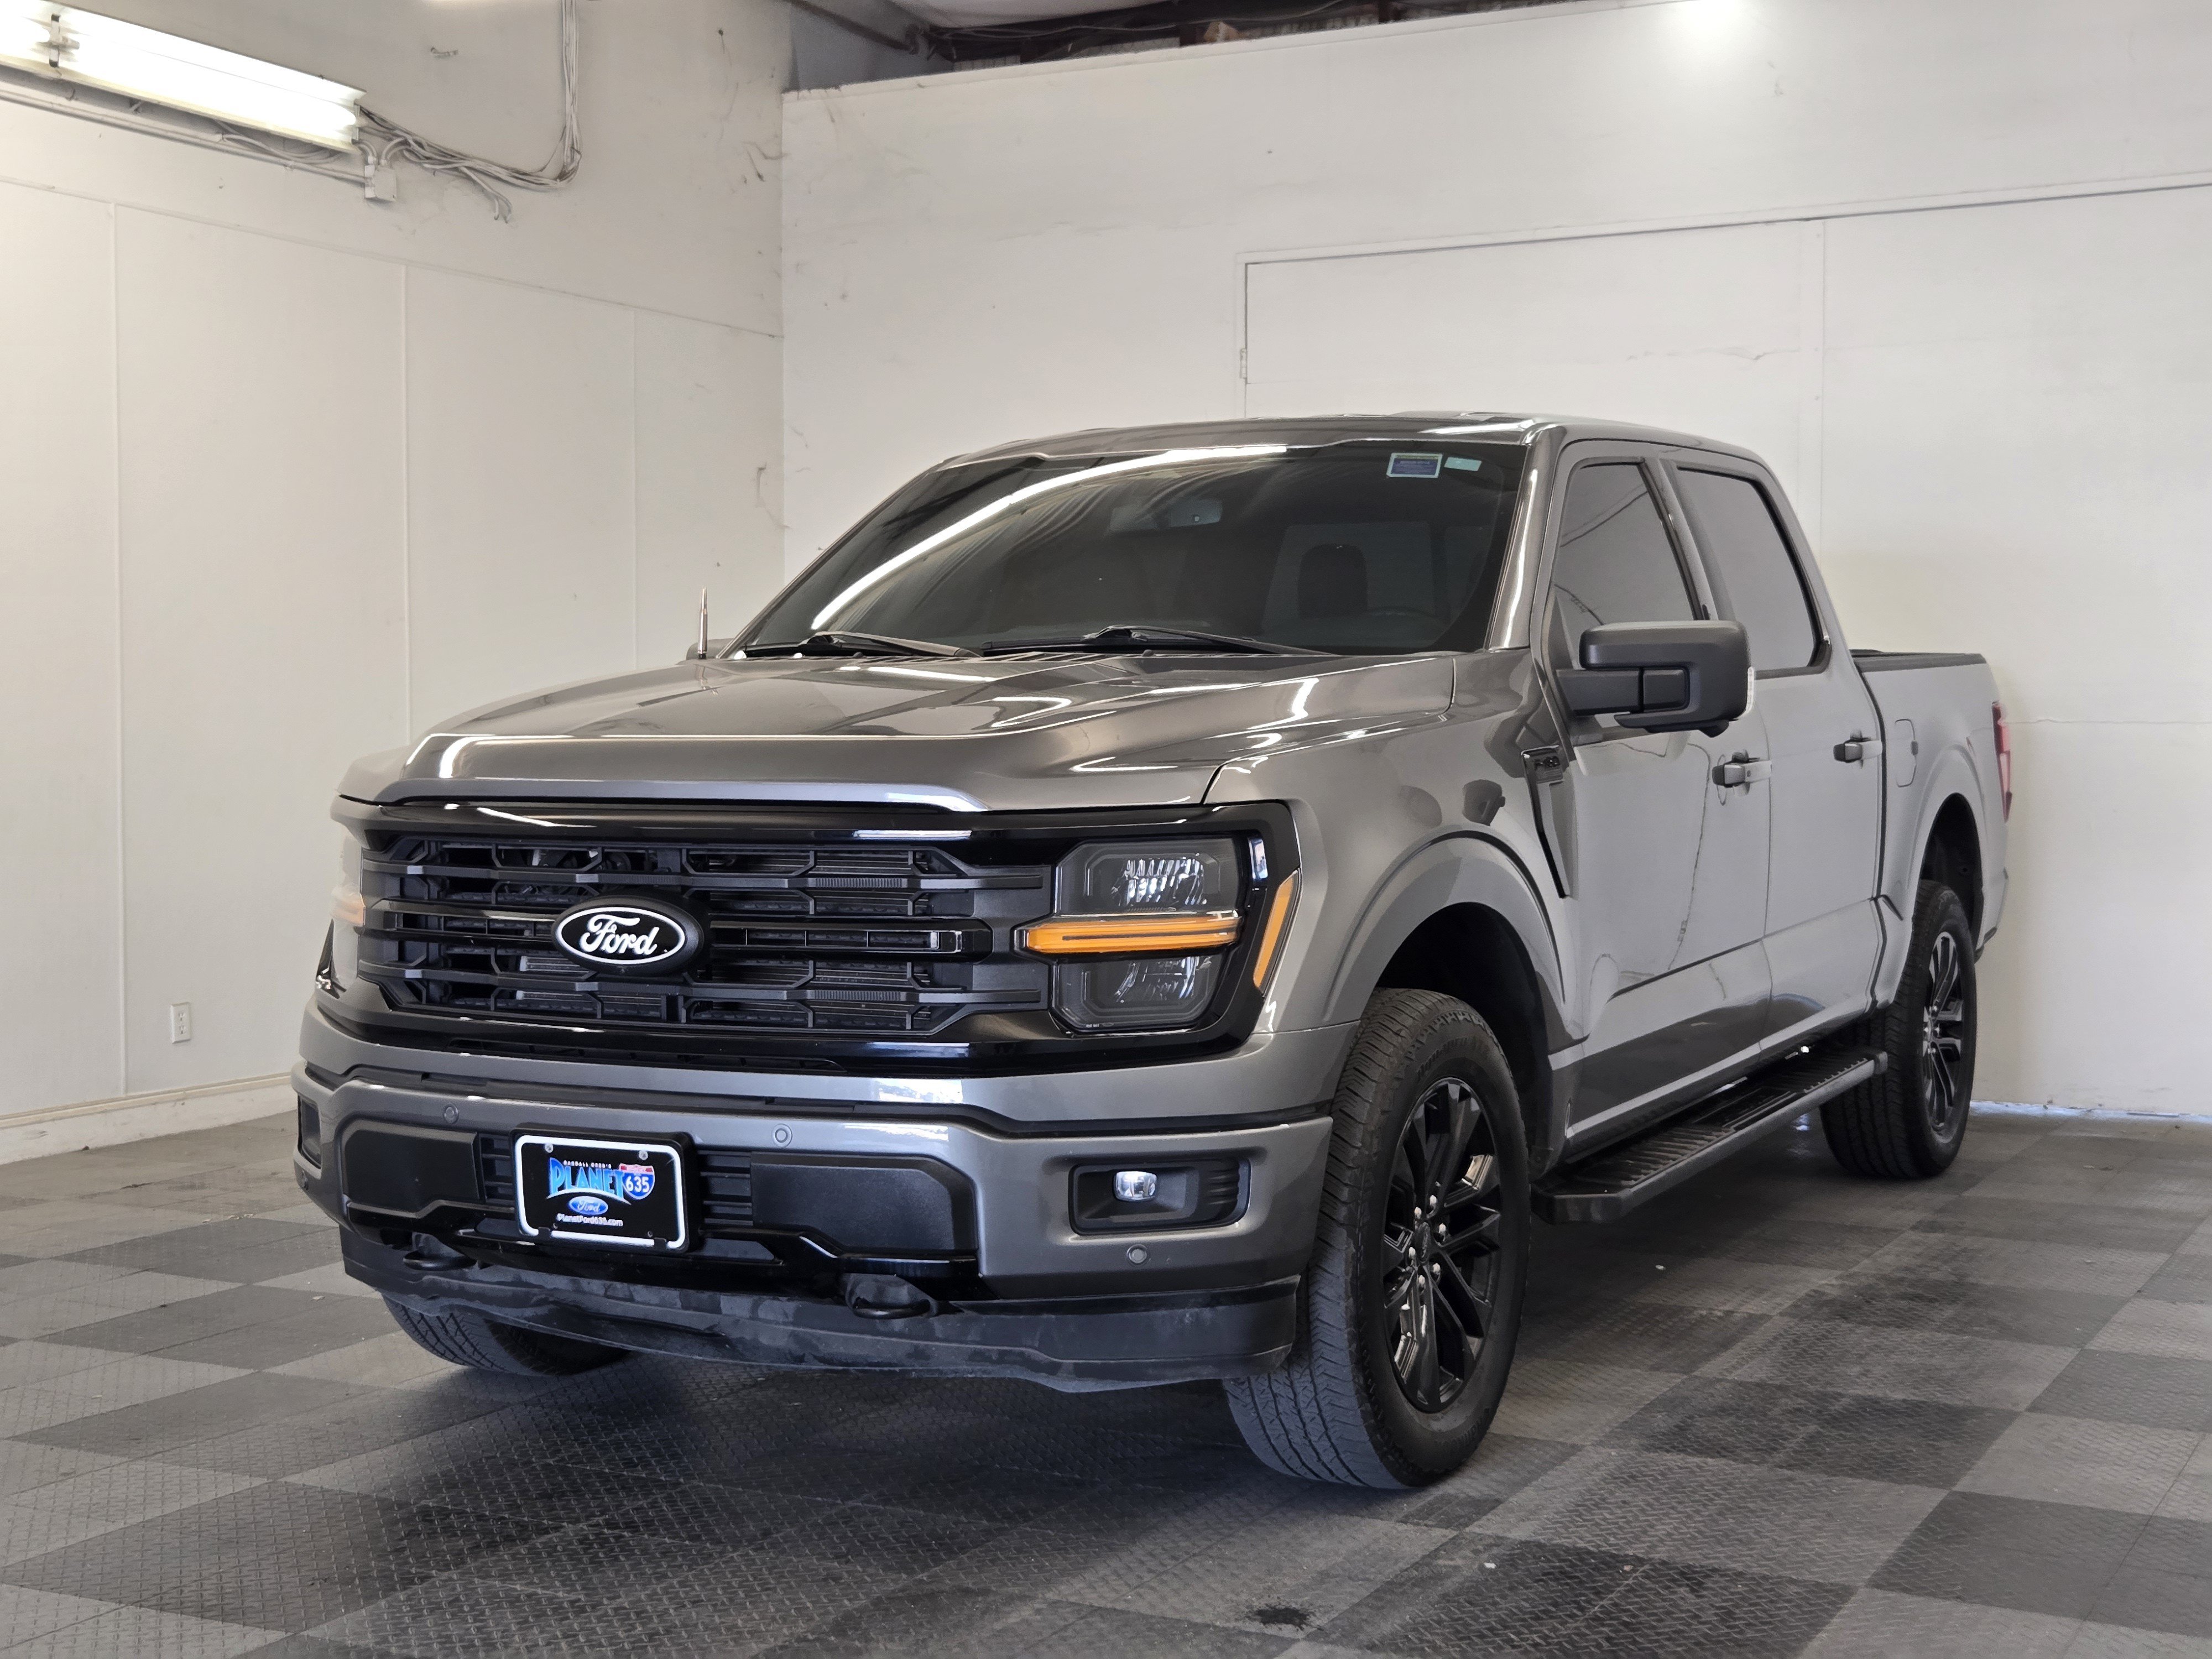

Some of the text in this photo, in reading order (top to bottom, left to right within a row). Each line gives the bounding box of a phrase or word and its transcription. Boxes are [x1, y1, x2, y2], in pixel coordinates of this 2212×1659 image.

[580, 914, 660, 956] Ford
[549, 1157, 625, 1199] PLANET
[625, 1175, 650, 1193] 635
